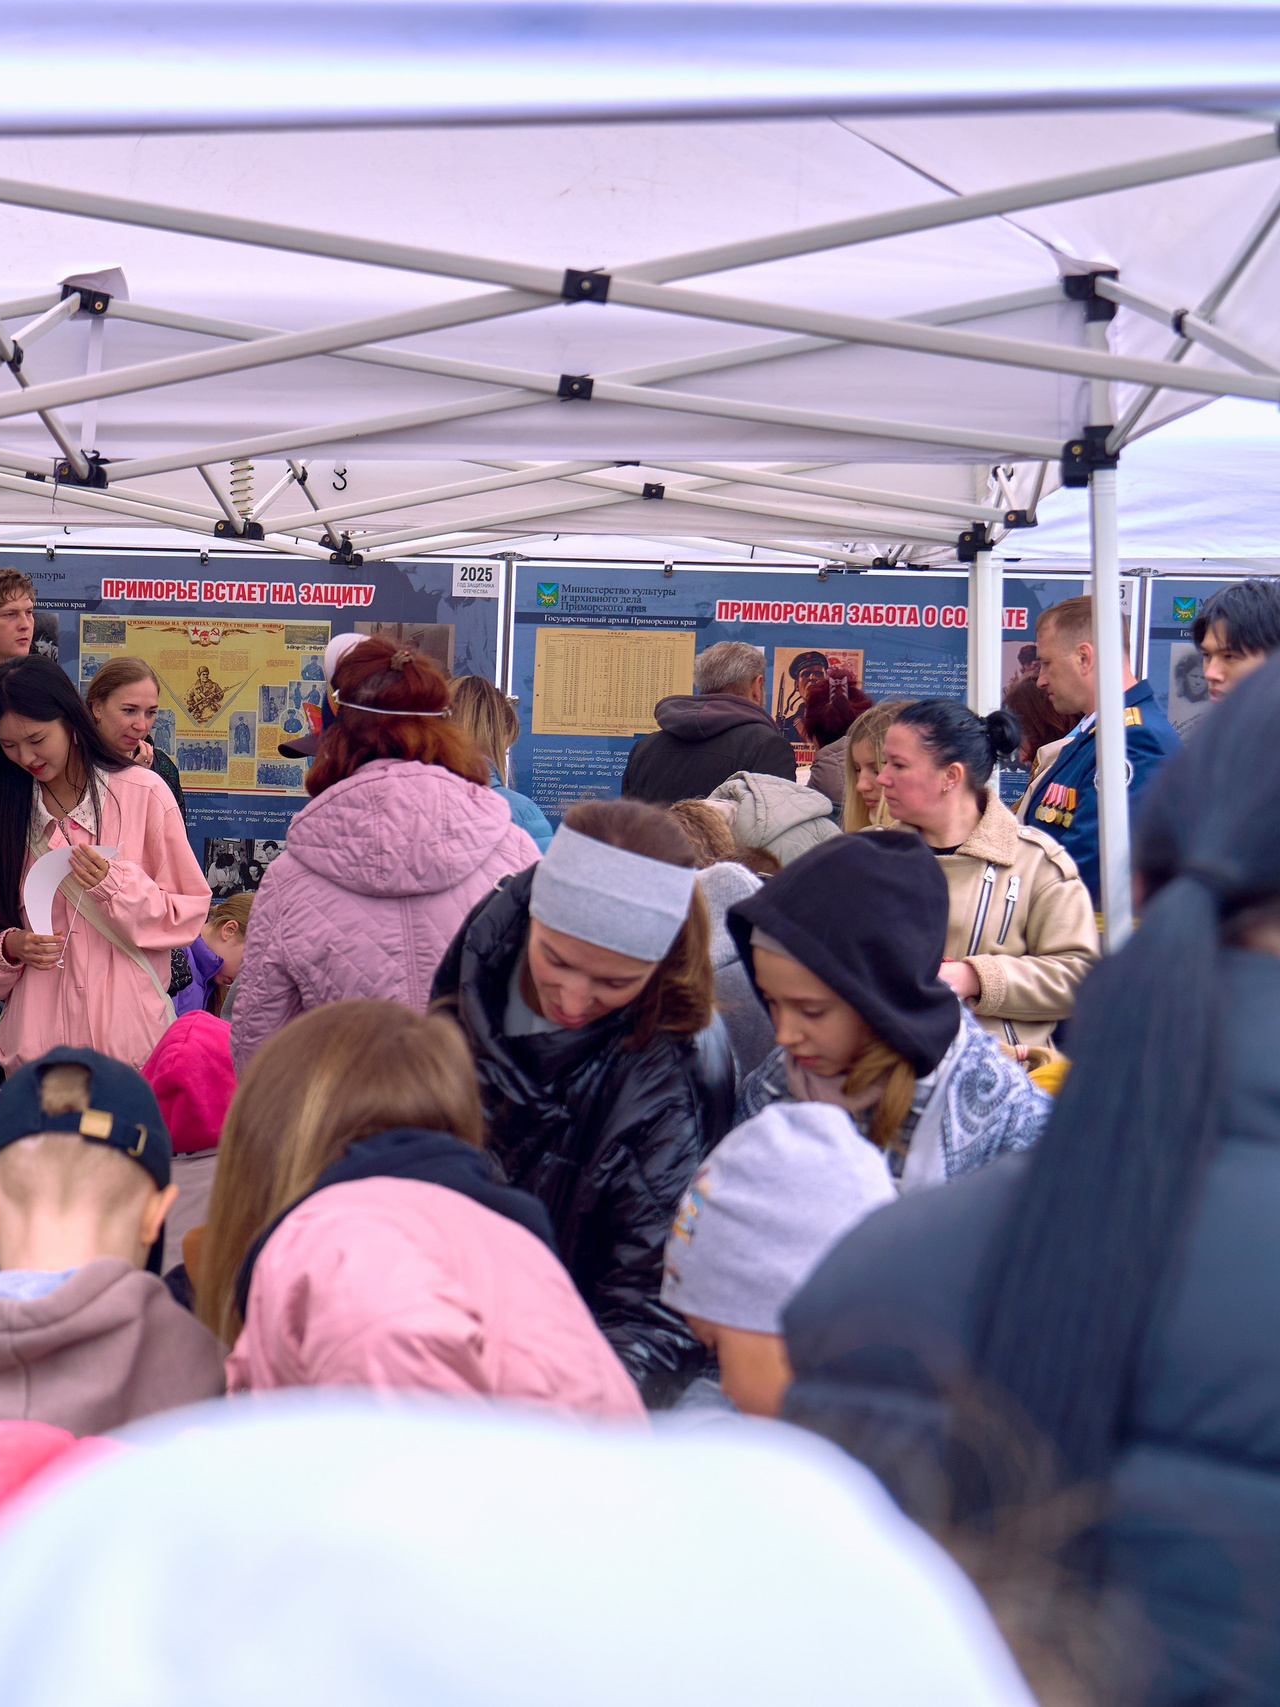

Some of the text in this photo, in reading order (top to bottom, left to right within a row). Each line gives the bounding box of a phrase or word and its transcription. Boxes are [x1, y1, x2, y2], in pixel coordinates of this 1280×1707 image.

[460, 566, 493, 582] 2025
[103, 579, 375, 608] ПРИМОРЬЕ ВСТАЕТ НА ЗАЩИТУ
[561, 584, 676, 597] Министерство культуры
[570, 595, 618, 605] архивного
[620, 596, 642, 604] дела
[560, 603, 647, 613] Приморского края
[544, 614, 607, 624] Государственный
[630, 617, 679, 626] Приморского
[717, 601, 1027, 629] ПРИМОРСКАЯ ЗАБОТА О СОТЕ
[565, 748, 593, 756] Приморья
[532, 768, 570, 776] Приморскому
